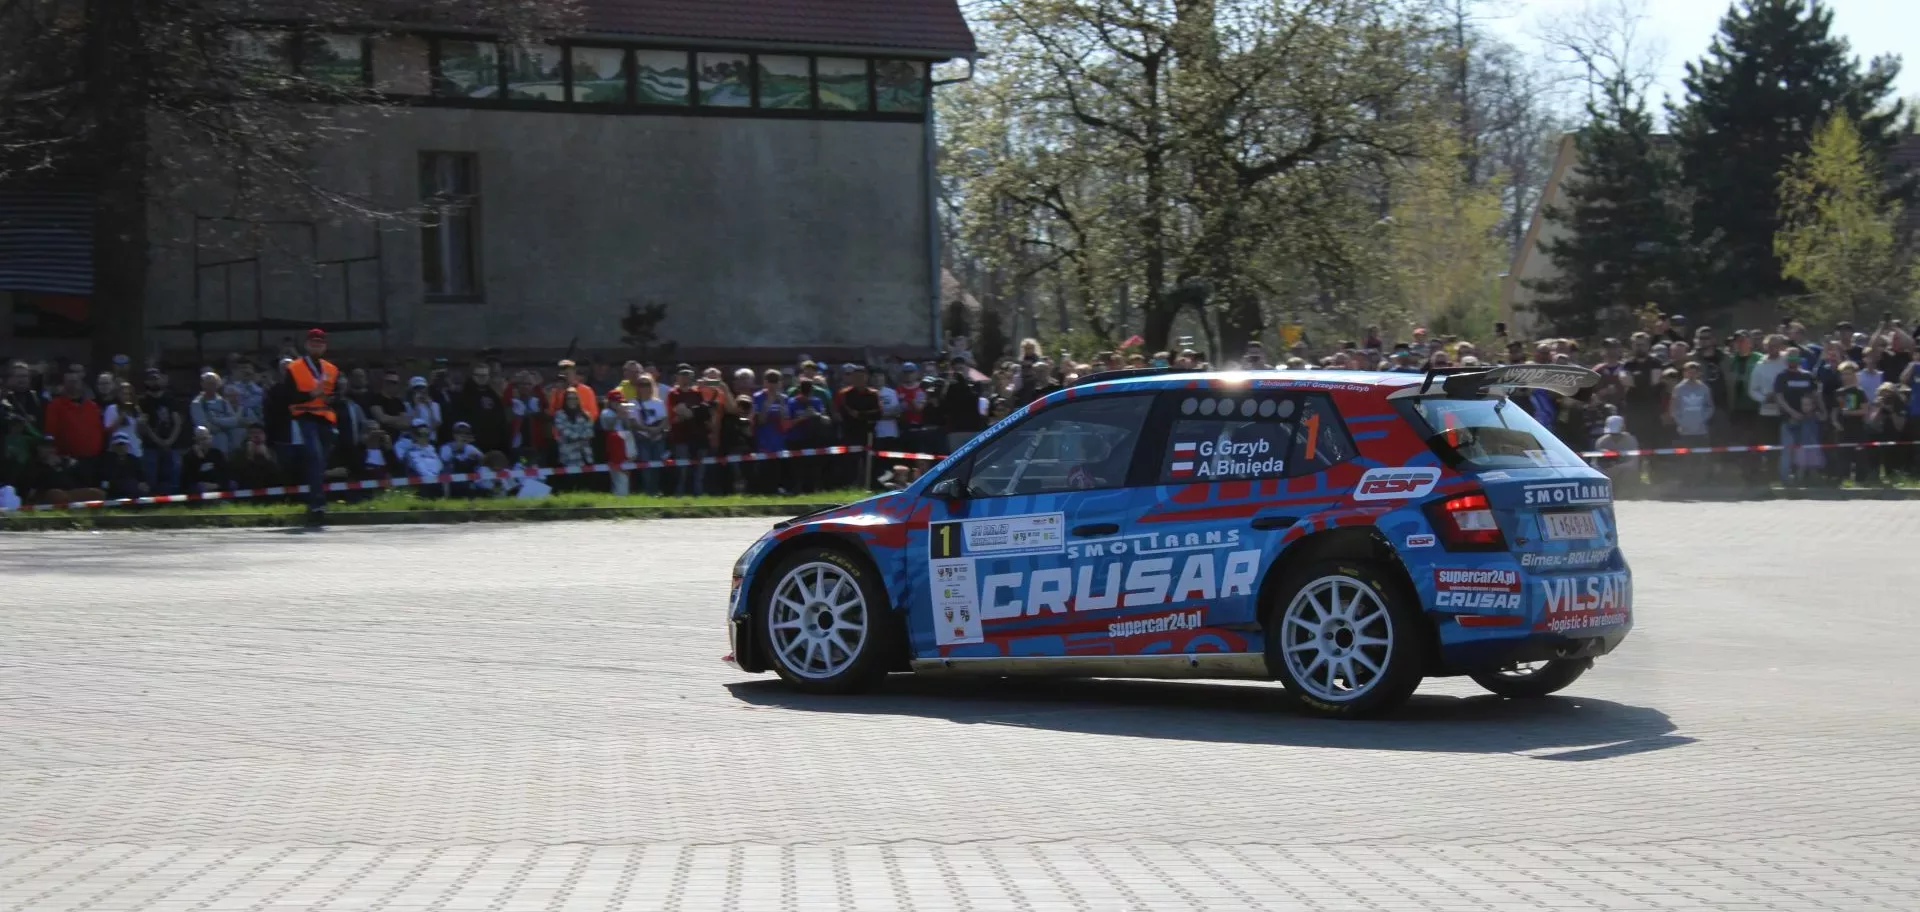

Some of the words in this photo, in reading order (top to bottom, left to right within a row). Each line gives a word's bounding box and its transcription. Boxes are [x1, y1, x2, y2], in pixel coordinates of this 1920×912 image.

[1312, 381, 1346, 391] Grzegorz
[1347, 384, 1370, 393] Grzyb
[1199, 438, 1270, 458] G.Grzyb
[1304, 412, 1320, 460] 1
[1197, 458, 1284, 477] A.Binięda
[940, 525, 951, 557] 1
[1067, 529, 1240, 560] SMOLTRANS
[981, 549, 1262, 620] CRUSAR
[1438, 570, 1516, 586] supercar24.pl
[1435, 591, 1521, 609] CRUSAR
[1541, 575, 1628, 613] VILSAIT
[1108, 611, 1202, 638] supercar24.pl
